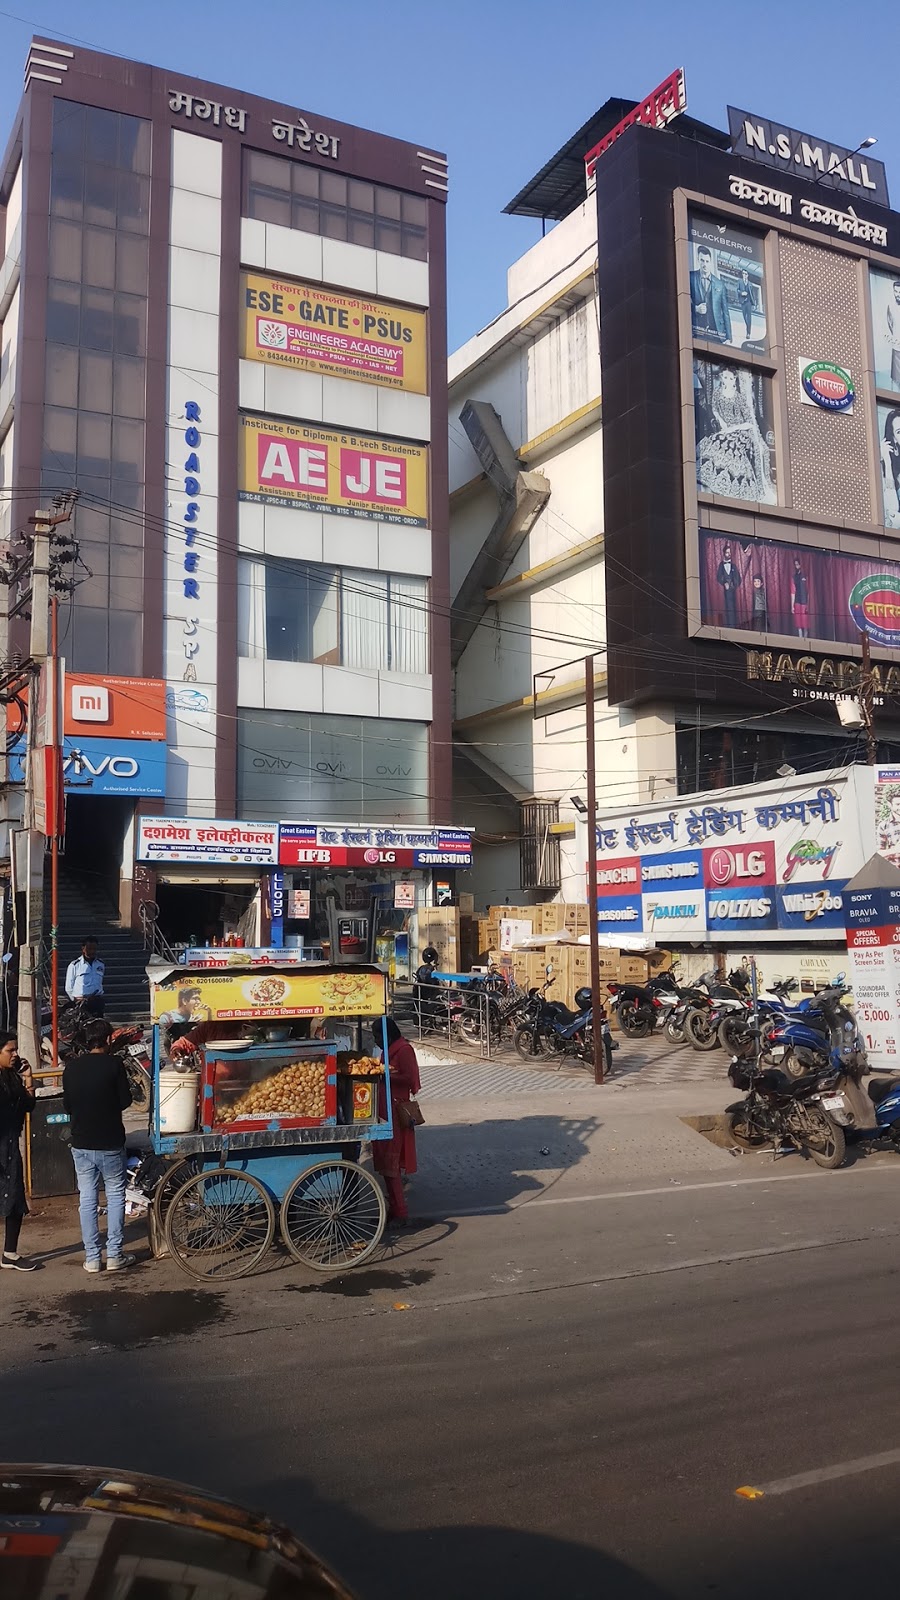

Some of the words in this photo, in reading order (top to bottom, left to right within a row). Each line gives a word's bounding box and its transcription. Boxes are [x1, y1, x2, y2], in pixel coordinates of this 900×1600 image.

[168, 89, 248, 133] मगध
[271, 118, 341, 159] नरेश
[690, 228, 754, 254] BLACKBERRYS
[246, 288, 284, 315] ESE
[299, 300, 349, 329] GATE
[364, 314, 413, 343] PSUs
[287, 328, 348, 348] ENGINEERS
[350, 341, 399, 359] ACADEMY
[290, 344, 301, 352] IES
[306, 348, 324, 357] GATE
[369, 361, 380, 369] IAS
[267, 351, 309, 367] 8434441777
[318, 361, 404, 387] www.engineersacademy.org
[814, 376, 845, 395] नागरमल
[242, 417, 284, 433] Institute
[286, 426, 300, 436] for
[303, 429, 338, 443] Diploma
[340, 436, 347, 444] &
[381, 443, 421, 456] Students
[261, 442, 326, 488] AE
[346, 457, 402, 500] JE
[184, 400, 201, 602] ROADSTER
[258, 485, 295, 497] Assistant
[297, 491, 329, 502] Engineer
[347, 499, 370, 509] Junior
[371, 503, 402, 514] Engineer
[103, 678, 129, 686] Authorised
[755, 788, 838, 829] कम्पनी
[142, 824, 192, 840] दशमेश
[297, 848, 331, 862] IFB
[378, 851, 395, 862] LG
[418, 853, 471, 864] SAMSUNG
[735, 850, 766, 877] LG
[641, 861, 699, 882] SAMSUNG
[273, 873, 283, 917] LLOYD
[850, 894, 872, 902] SONY
[654, 903, 700, 919] DAIKIN
[708, 898, 771, 918] VOLTAS
[850, 908, 878, 917] BRAVIA
[853, 936, 880, 945] OFFERS!
[857, 1001, 873, 1009] Save
